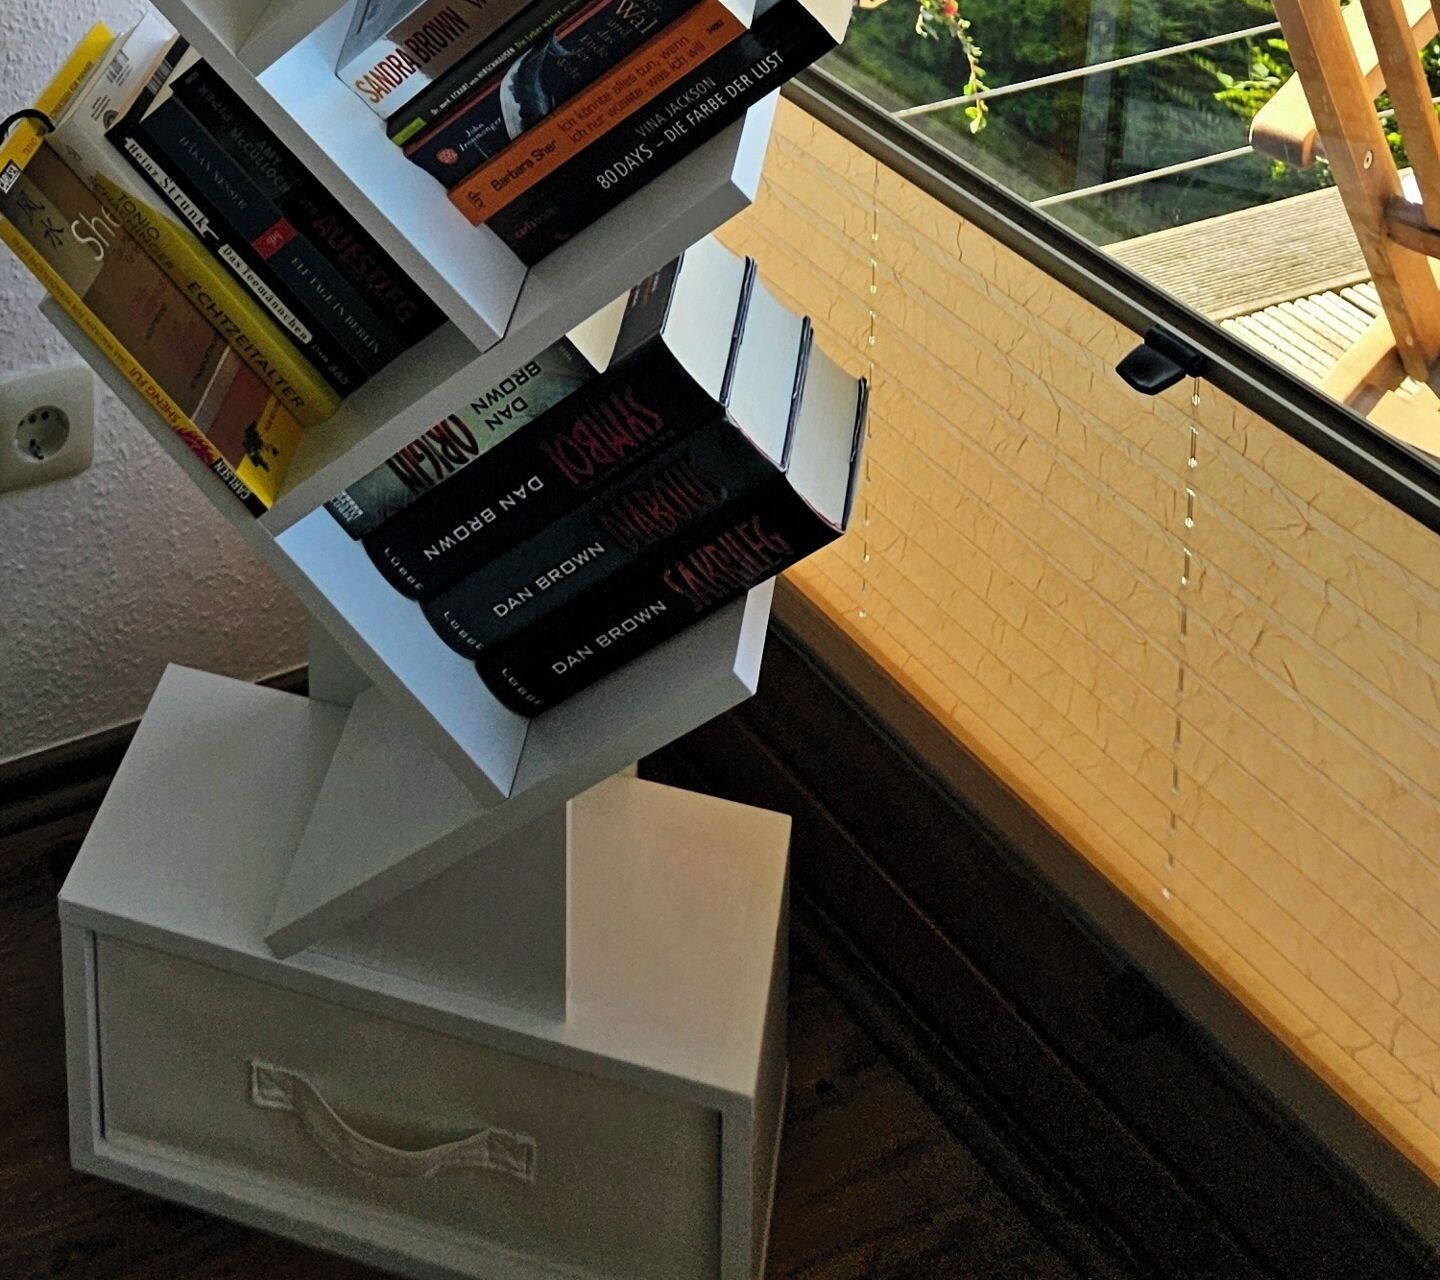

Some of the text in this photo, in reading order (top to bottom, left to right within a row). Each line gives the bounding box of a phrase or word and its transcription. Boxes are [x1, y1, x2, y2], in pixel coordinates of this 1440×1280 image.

[353, 6, 471, 107] SANDRA BROWN
[663, 48, 786, 144] DIE FARBE DER LUST
[635, 73, 717, 140] VINA JACKSON
[125, 139, 209, 231] Heinz Strunk
[490, 135, 560, 192] Barbara Sher
[221, 245, 311, 344] Das Teemännchen
[184, 273, 306, 416] ECHTZEITALTER
[468, 359, 542, 416] BROWN
[384, 411, 483, 499] ORIGIN
[482, 394, 529, 433] DAN
[211, 459, 251, 501] CARLSEN
[420, 472, 544, 563] DAN BROWN
[492, 535, 607, 621] DAN BROWN
[659, 500, 795, 624] SAKRILEG
[550, 593, 668, 680] DAN BROWN
